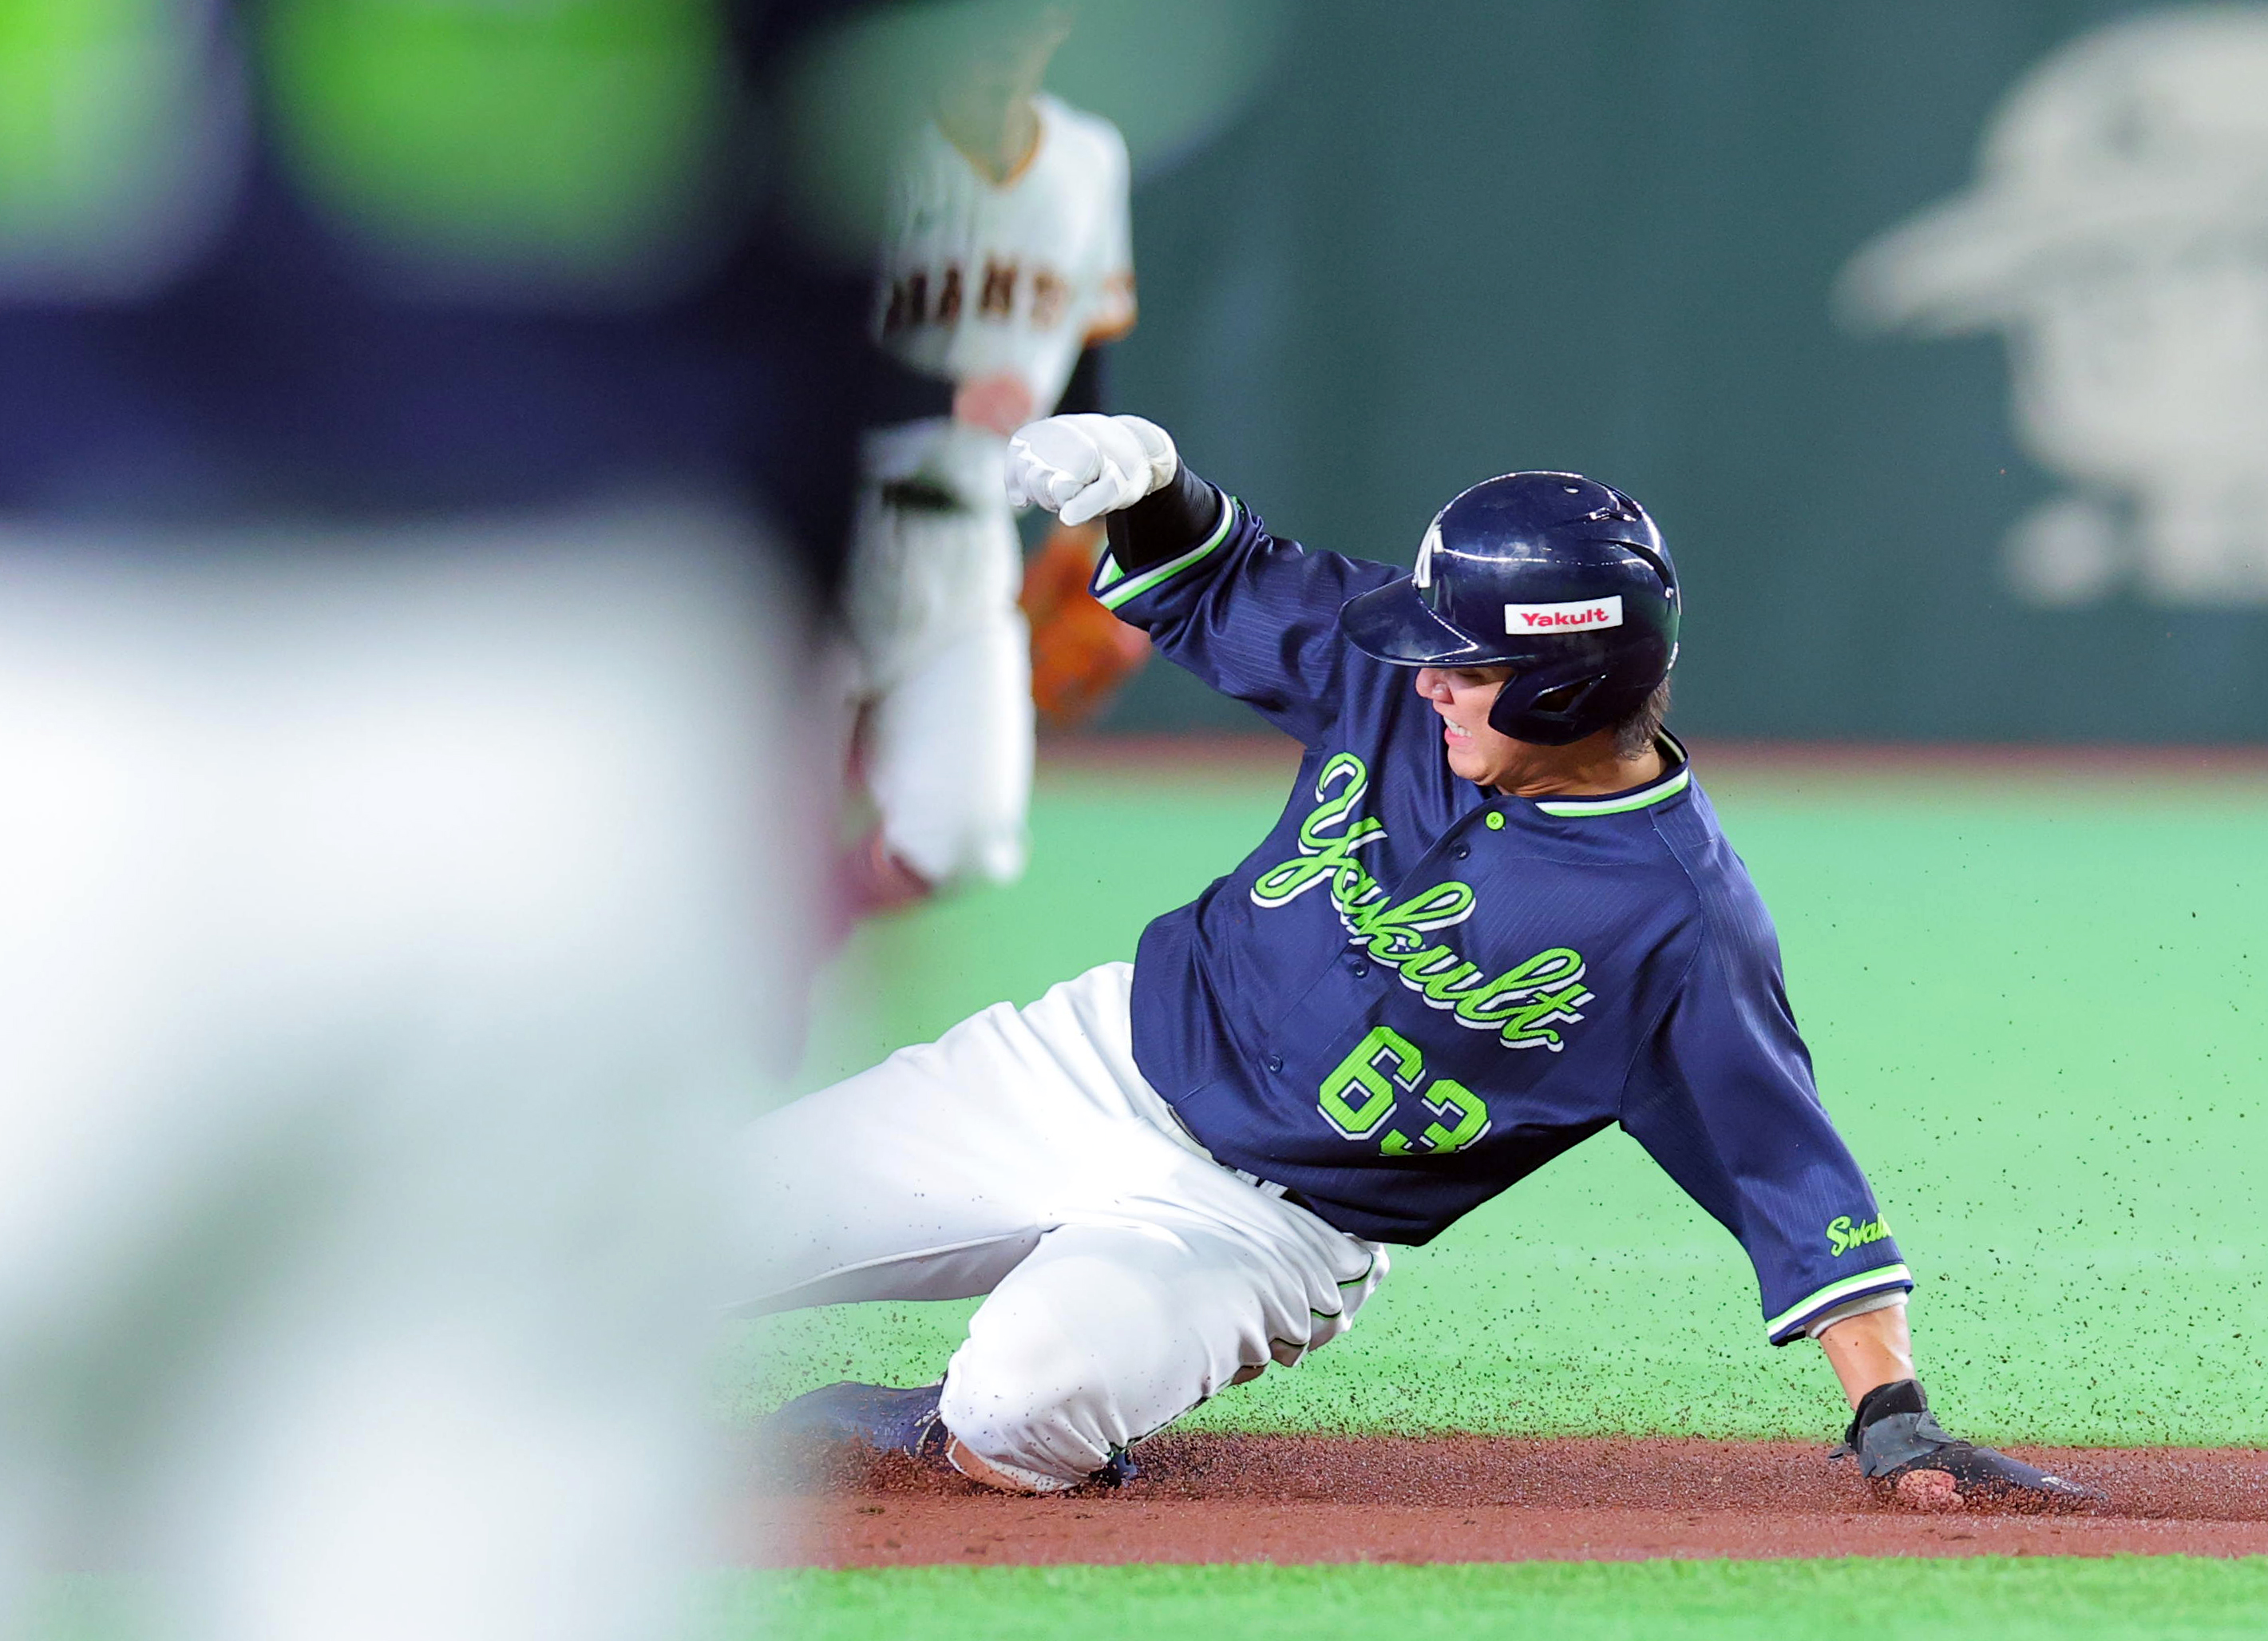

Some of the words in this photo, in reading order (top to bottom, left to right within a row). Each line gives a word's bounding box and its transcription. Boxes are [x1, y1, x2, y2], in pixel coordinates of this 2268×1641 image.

[1521, 608, 1609, 627] Yakult
[1250, 751, 1597, 1052] Yakult
[1316, 1025, 1491, 1157] 63
